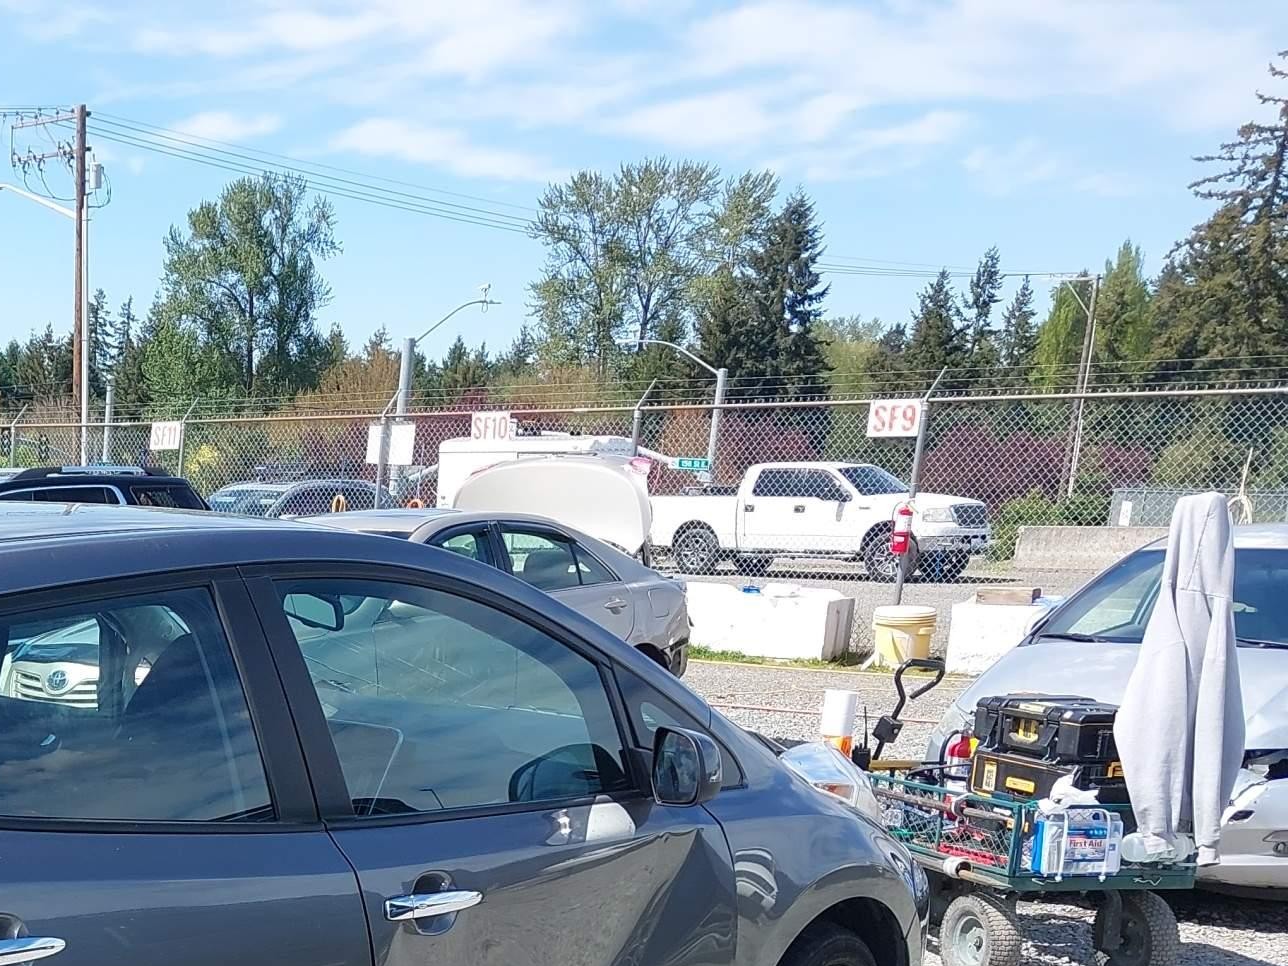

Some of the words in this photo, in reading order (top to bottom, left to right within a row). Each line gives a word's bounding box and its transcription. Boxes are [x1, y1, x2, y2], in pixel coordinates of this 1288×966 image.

[473, 416, 508, 440] SF10
[873, 404, 916, 432] SF9
[153, 425, 177, 446] SF11
[1069, 839, 1087, 848] First
[1088, 839, 1103, 848] Aid
